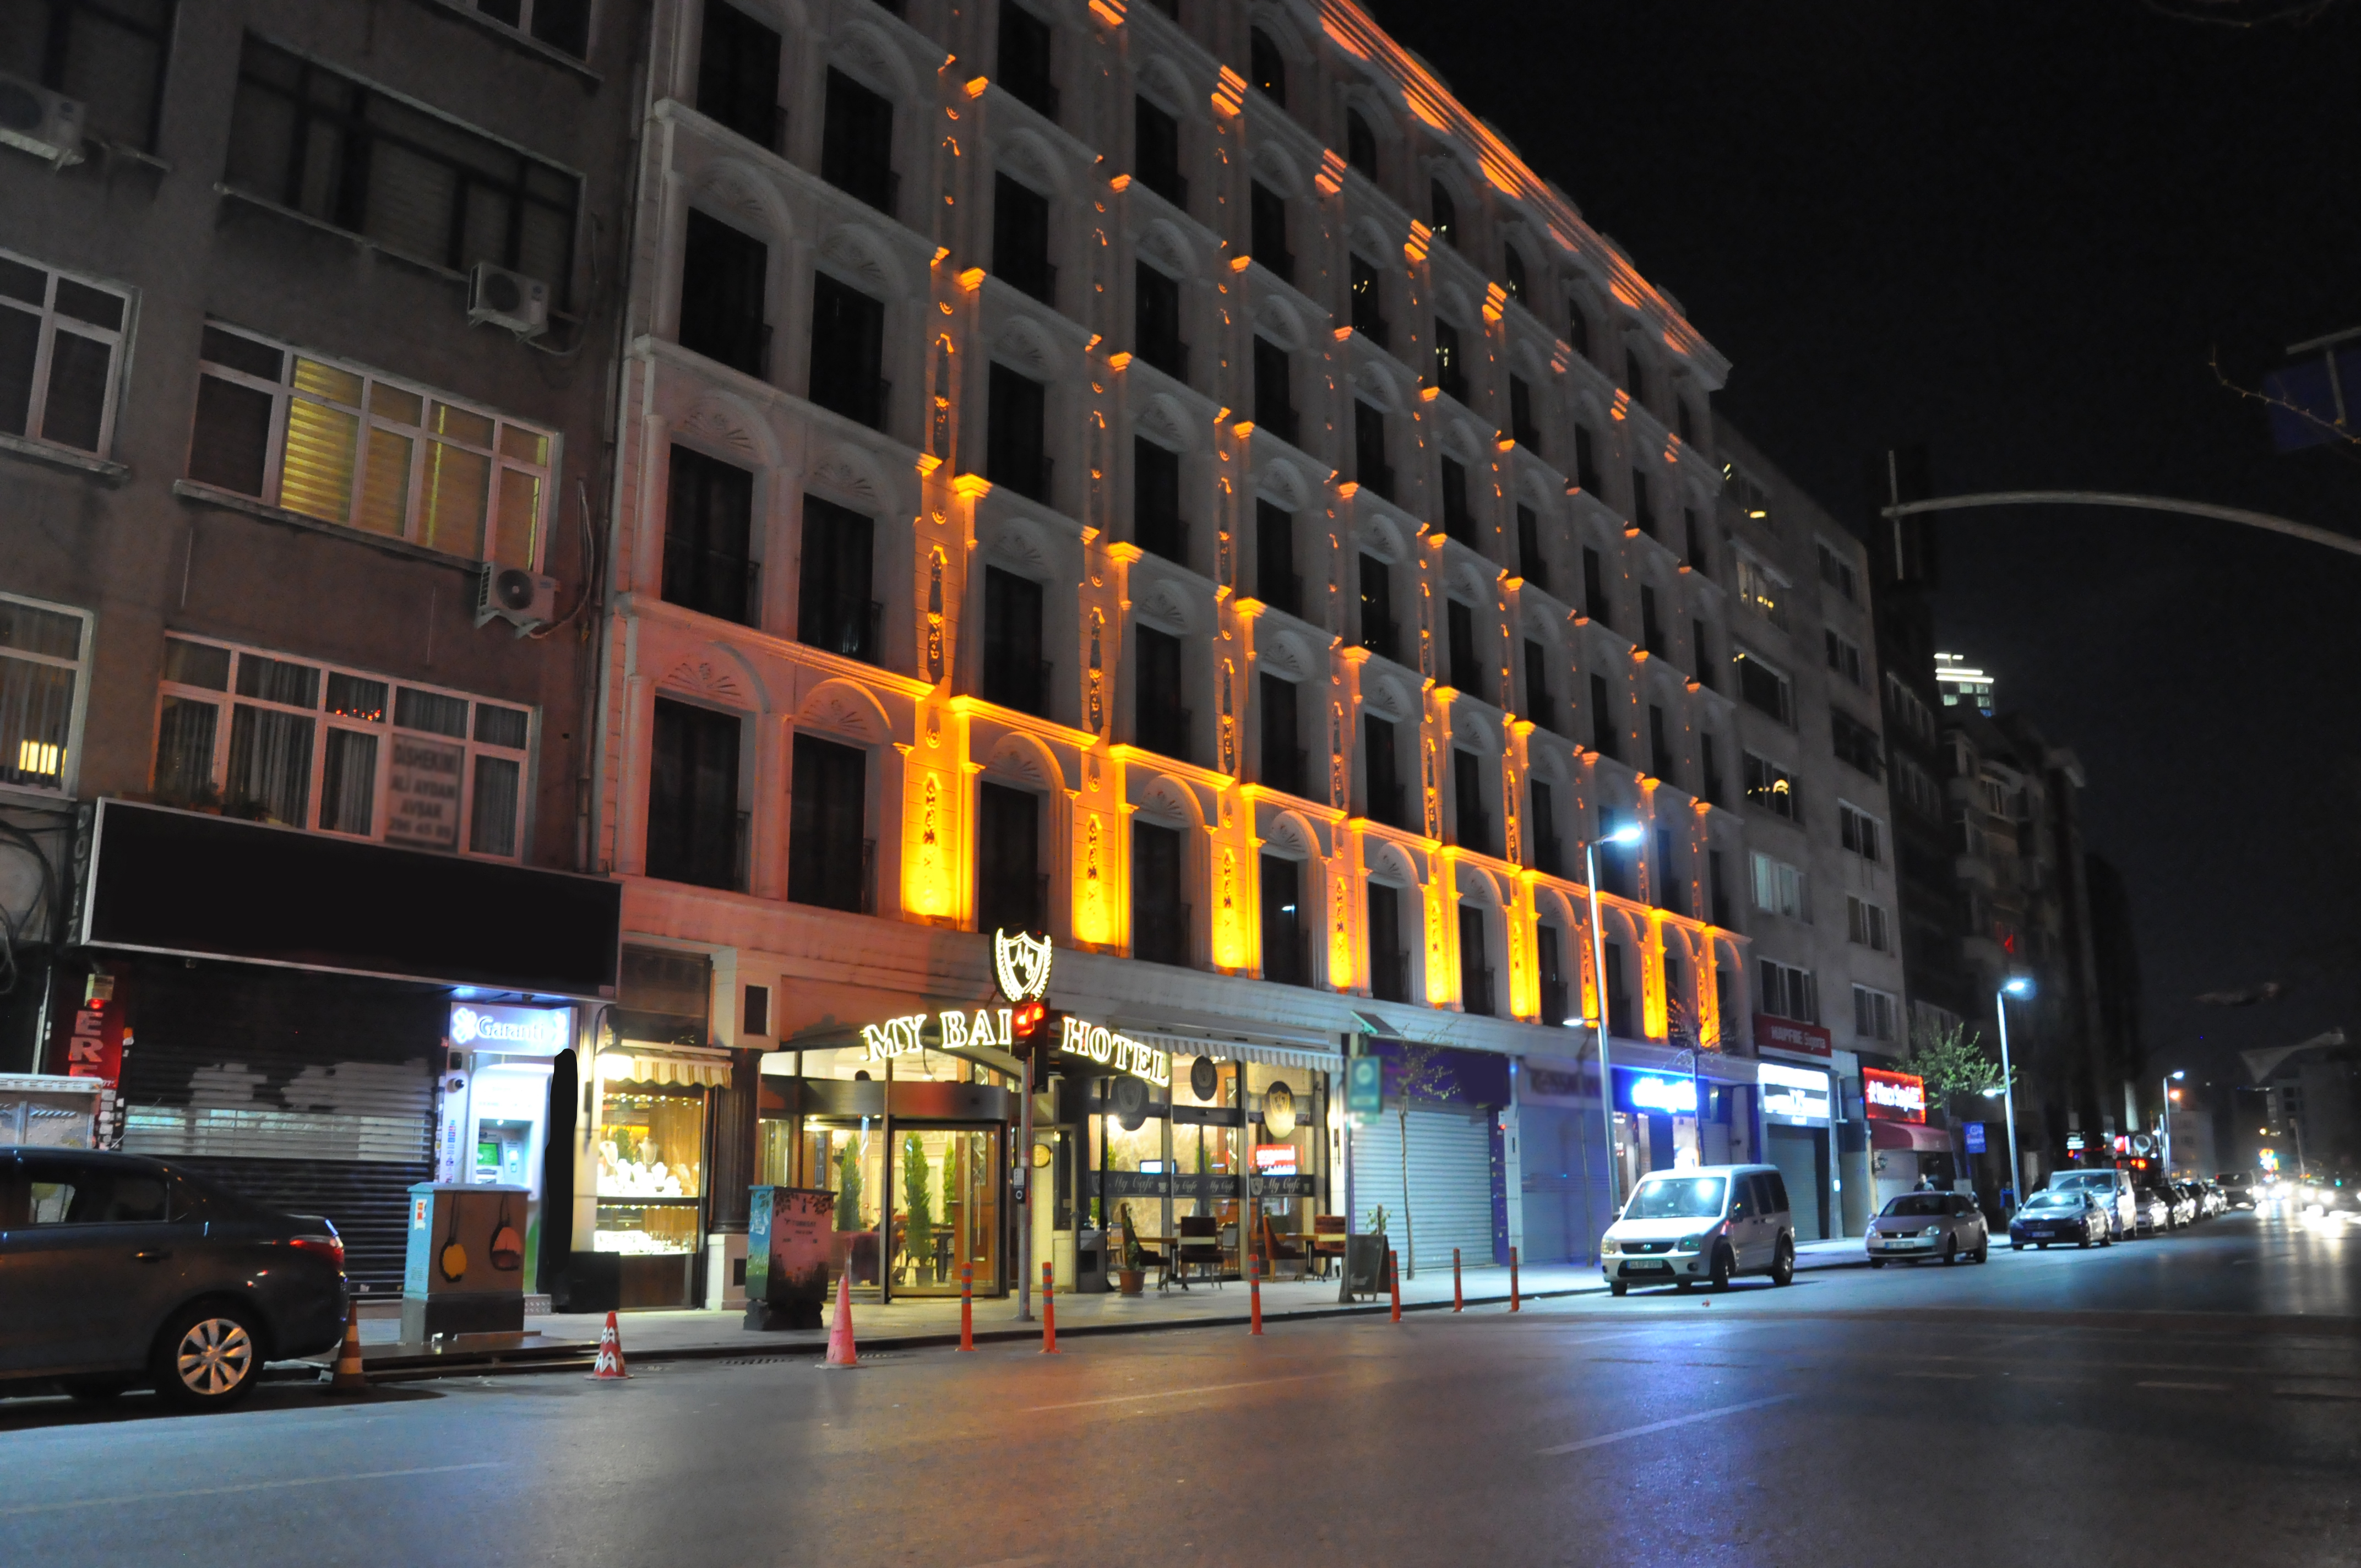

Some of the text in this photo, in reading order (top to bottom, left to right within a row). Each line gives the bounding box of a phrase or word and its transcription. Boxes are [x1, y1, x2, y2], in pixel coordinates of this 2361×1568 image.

[476, 1016, 544, 1040] Garanti
[861, 1014, 927, 1063] MY
[1062, 1016, 1169, 1087] HOTEL
